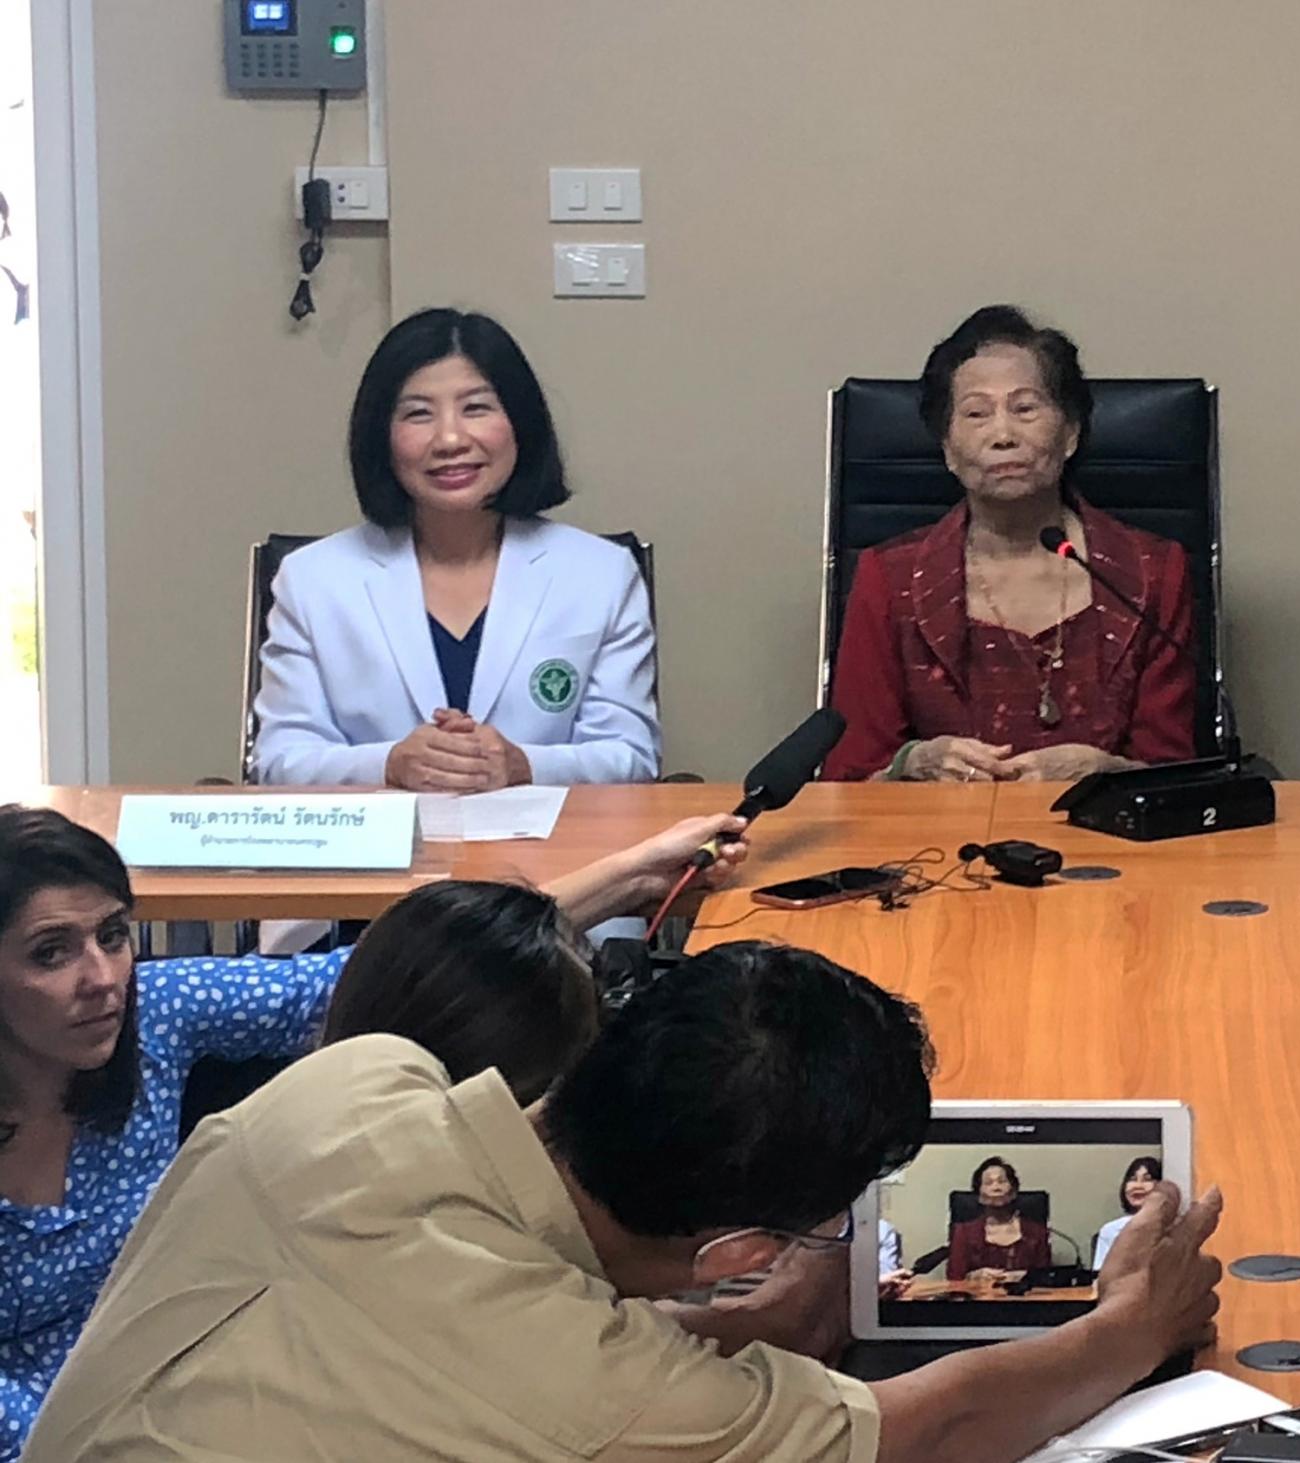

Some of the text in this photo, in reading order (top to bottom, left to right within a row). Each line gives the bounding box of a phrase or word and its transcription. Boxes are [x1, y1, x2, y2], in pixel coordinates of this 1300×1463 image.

[169, 806, 366, 830] พญ.ดารารัตน์ รัตนรักษ์
[1203, 807, 1216, 826] 2
